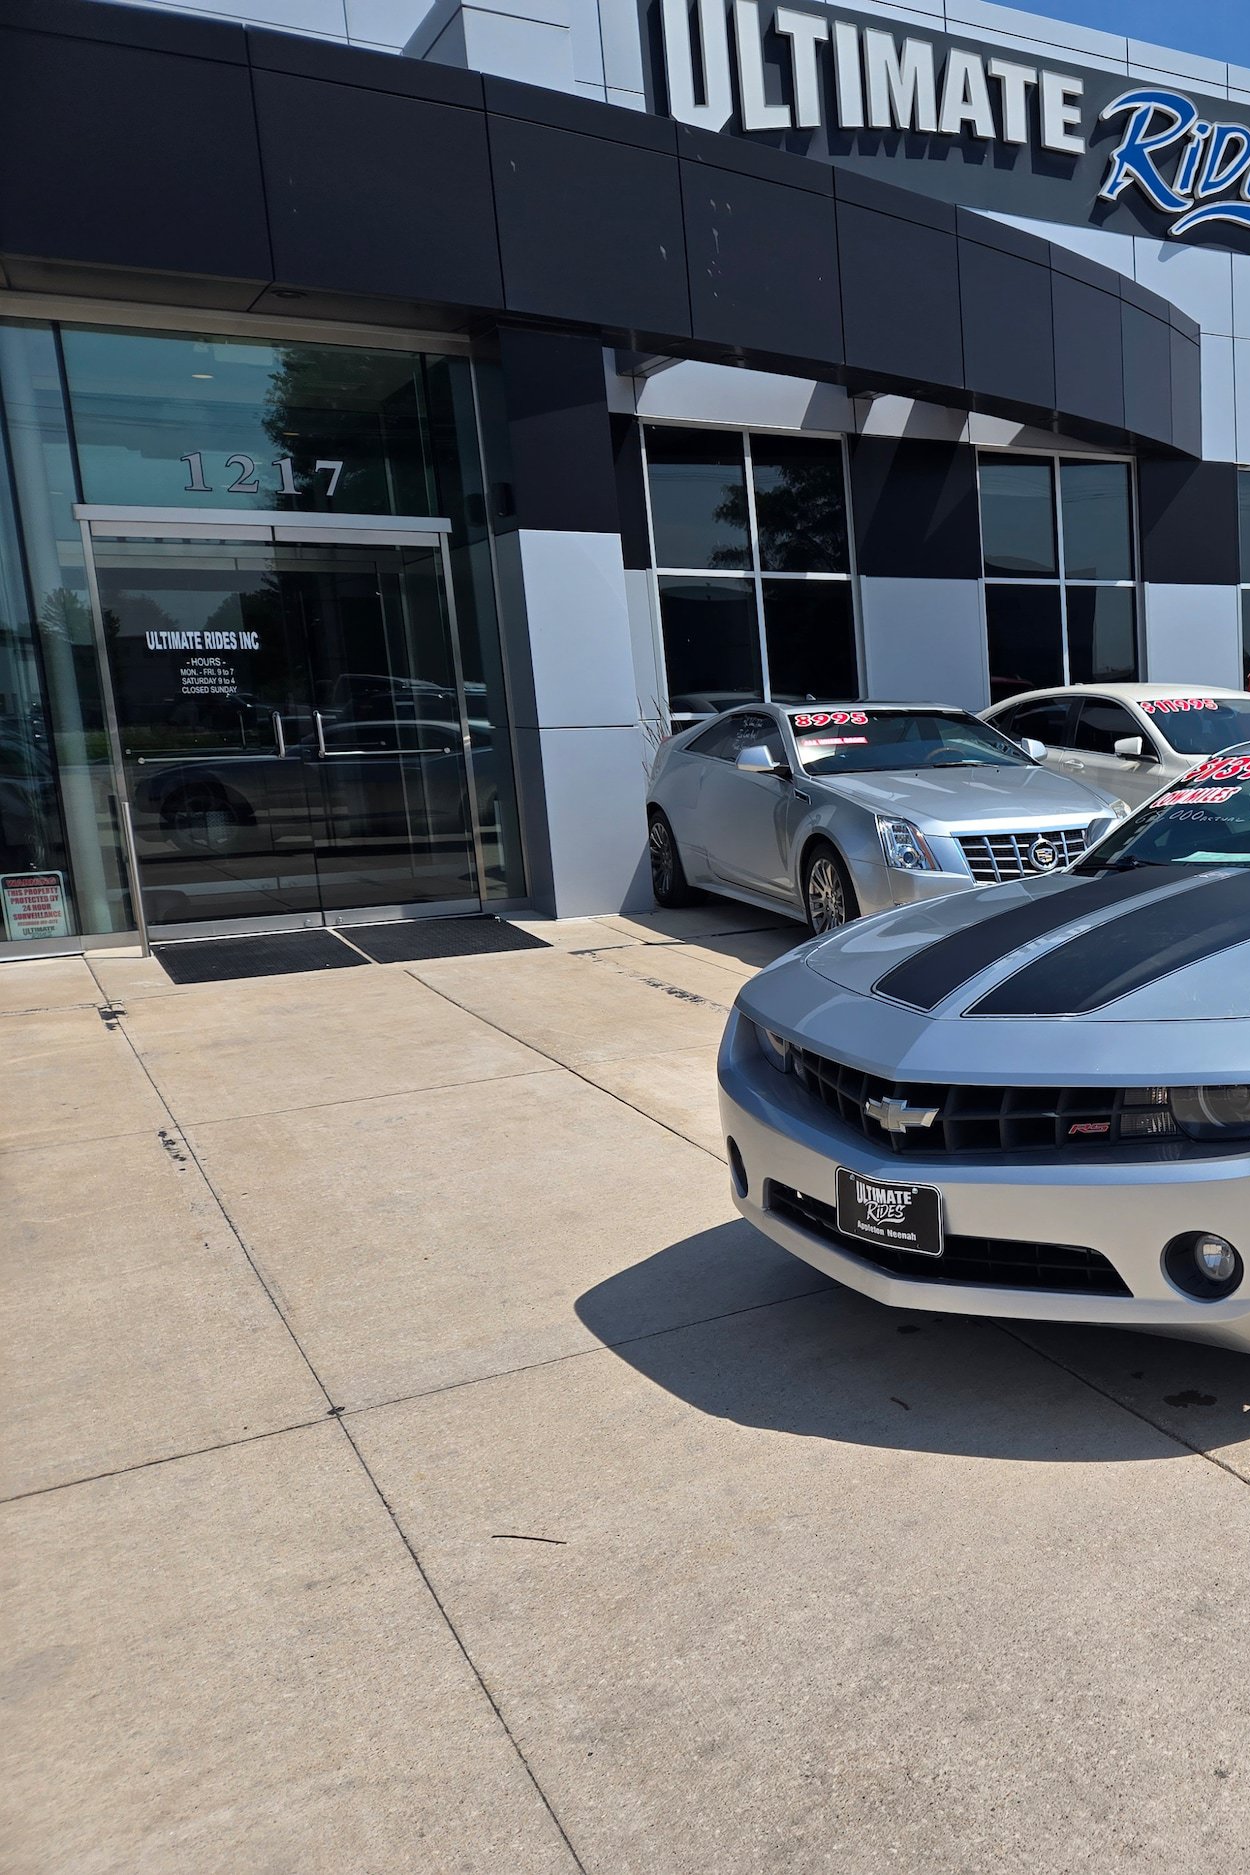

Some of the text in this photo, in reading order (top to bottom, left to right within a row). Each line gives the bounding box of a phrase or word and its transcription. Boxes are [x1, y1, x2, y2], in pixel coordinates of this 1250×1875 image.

[661, 0, 1085, 154] ULTIMATE
[180, 452, 344, 497] 1217
[146, 631, 259, 650] ULTIMATE RIDES INC
[191, 657, 221, 666] HOURS
[182, 677, 216, 685] SATURDAY
[182, 686, 237, 694] CLOSED SUNDAY
[795, 712, 869, 727] 8995
[856, 1181, 912, 1205] ULTIMATE
[857, 1220, 917, 1241] Appleton Neenah
